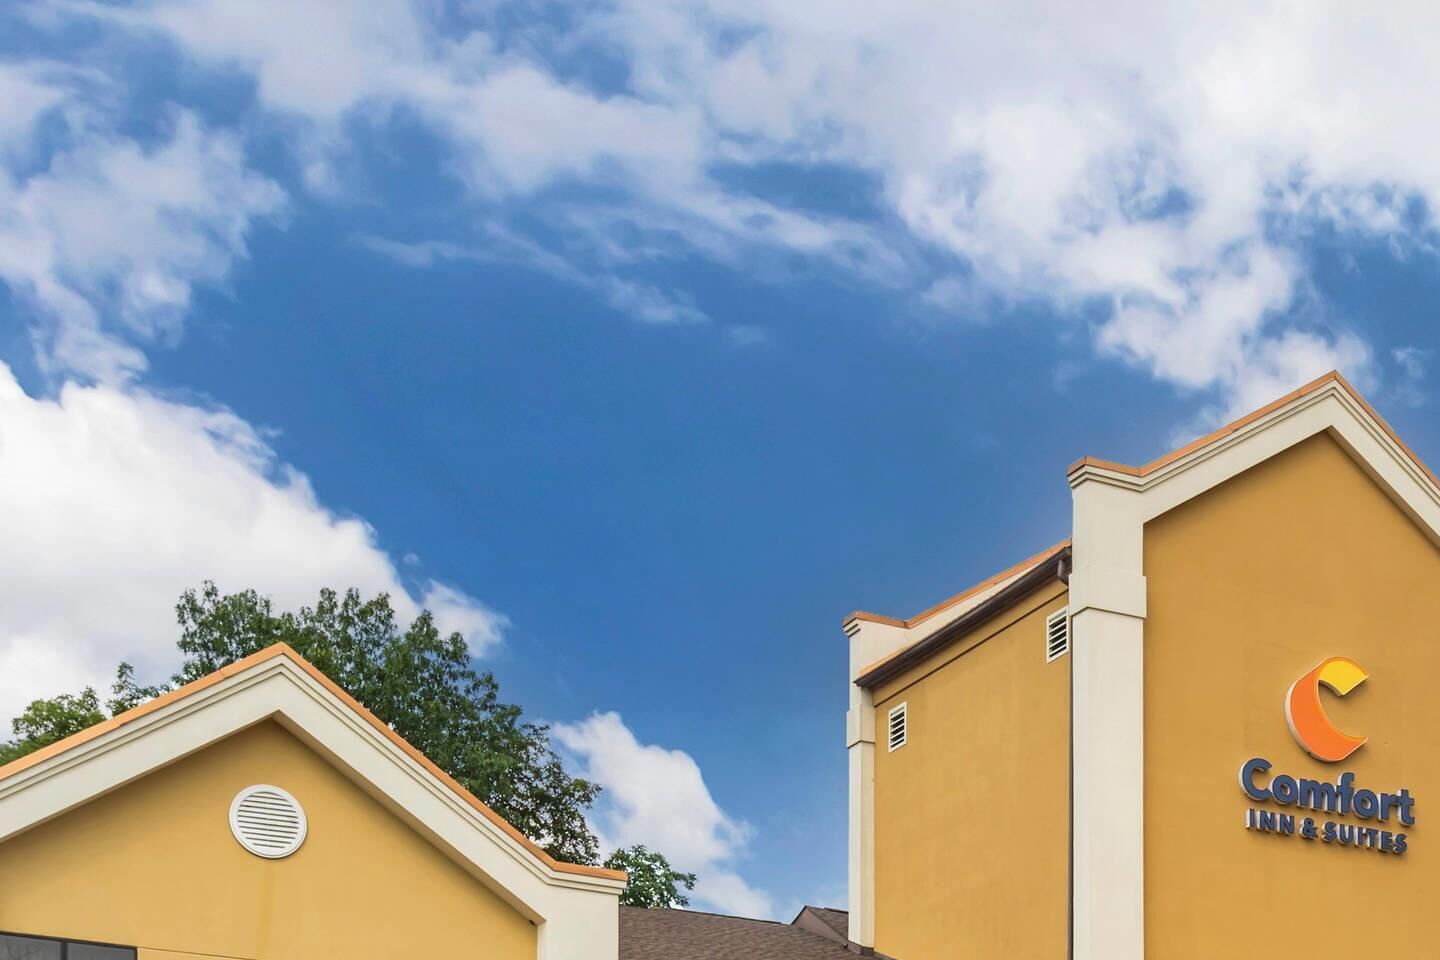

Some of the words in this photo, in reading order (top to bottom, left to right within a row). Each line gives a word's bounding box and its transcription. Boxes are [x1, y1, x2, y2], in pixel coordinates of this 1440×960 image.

[1239, 757, 1415, 825] Comfort
[1246, 808, 1295, 835] INN
[1300, 817, 1318, 839] &
[1321, 821, 1408, 853] SUITES
